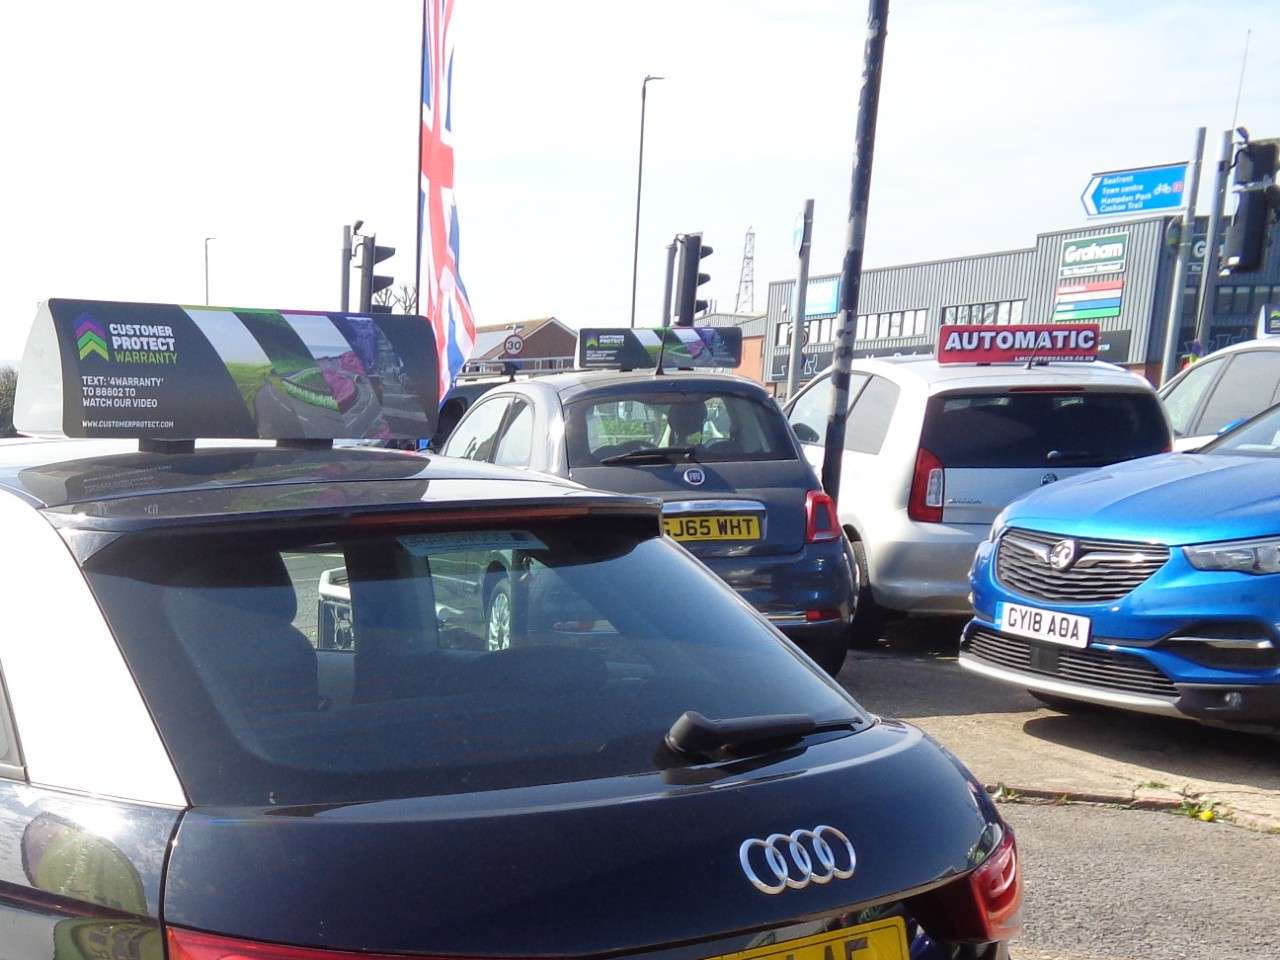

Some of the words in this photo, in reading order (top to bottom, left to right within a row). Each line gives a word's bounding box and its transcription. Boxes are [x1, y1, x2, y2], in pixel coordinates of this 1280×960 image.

[1102, 186, 1120, 195] Town
[1065, 242, 1124, 263] Graham
[109, 323, 174, 337] CUSTOMER
[112, 336, 176, 351] PROTECT
[507, 341, 521, 350] 30
[944, 330, 1095, 351] AUTOMATIC
[114, 351, 178, 364] WARRANTY
[82, 376, 107, 386] TEXT:
[82, 387, 94, 396] TO
[125, 388, 136, 397] TO
[82, 397, 113, 408] WATCH
[113, 398, 132, 408] OUR
[132, 398, 158, 408] VIDEO
[82, 420, 174, 428] WWW.CUSTOMERPROTECT.COM
[716, 519, 753, 536] WHT
[1008, 607, 1043, 632] GY18
[1047, 615, 1080, 640] AOA
